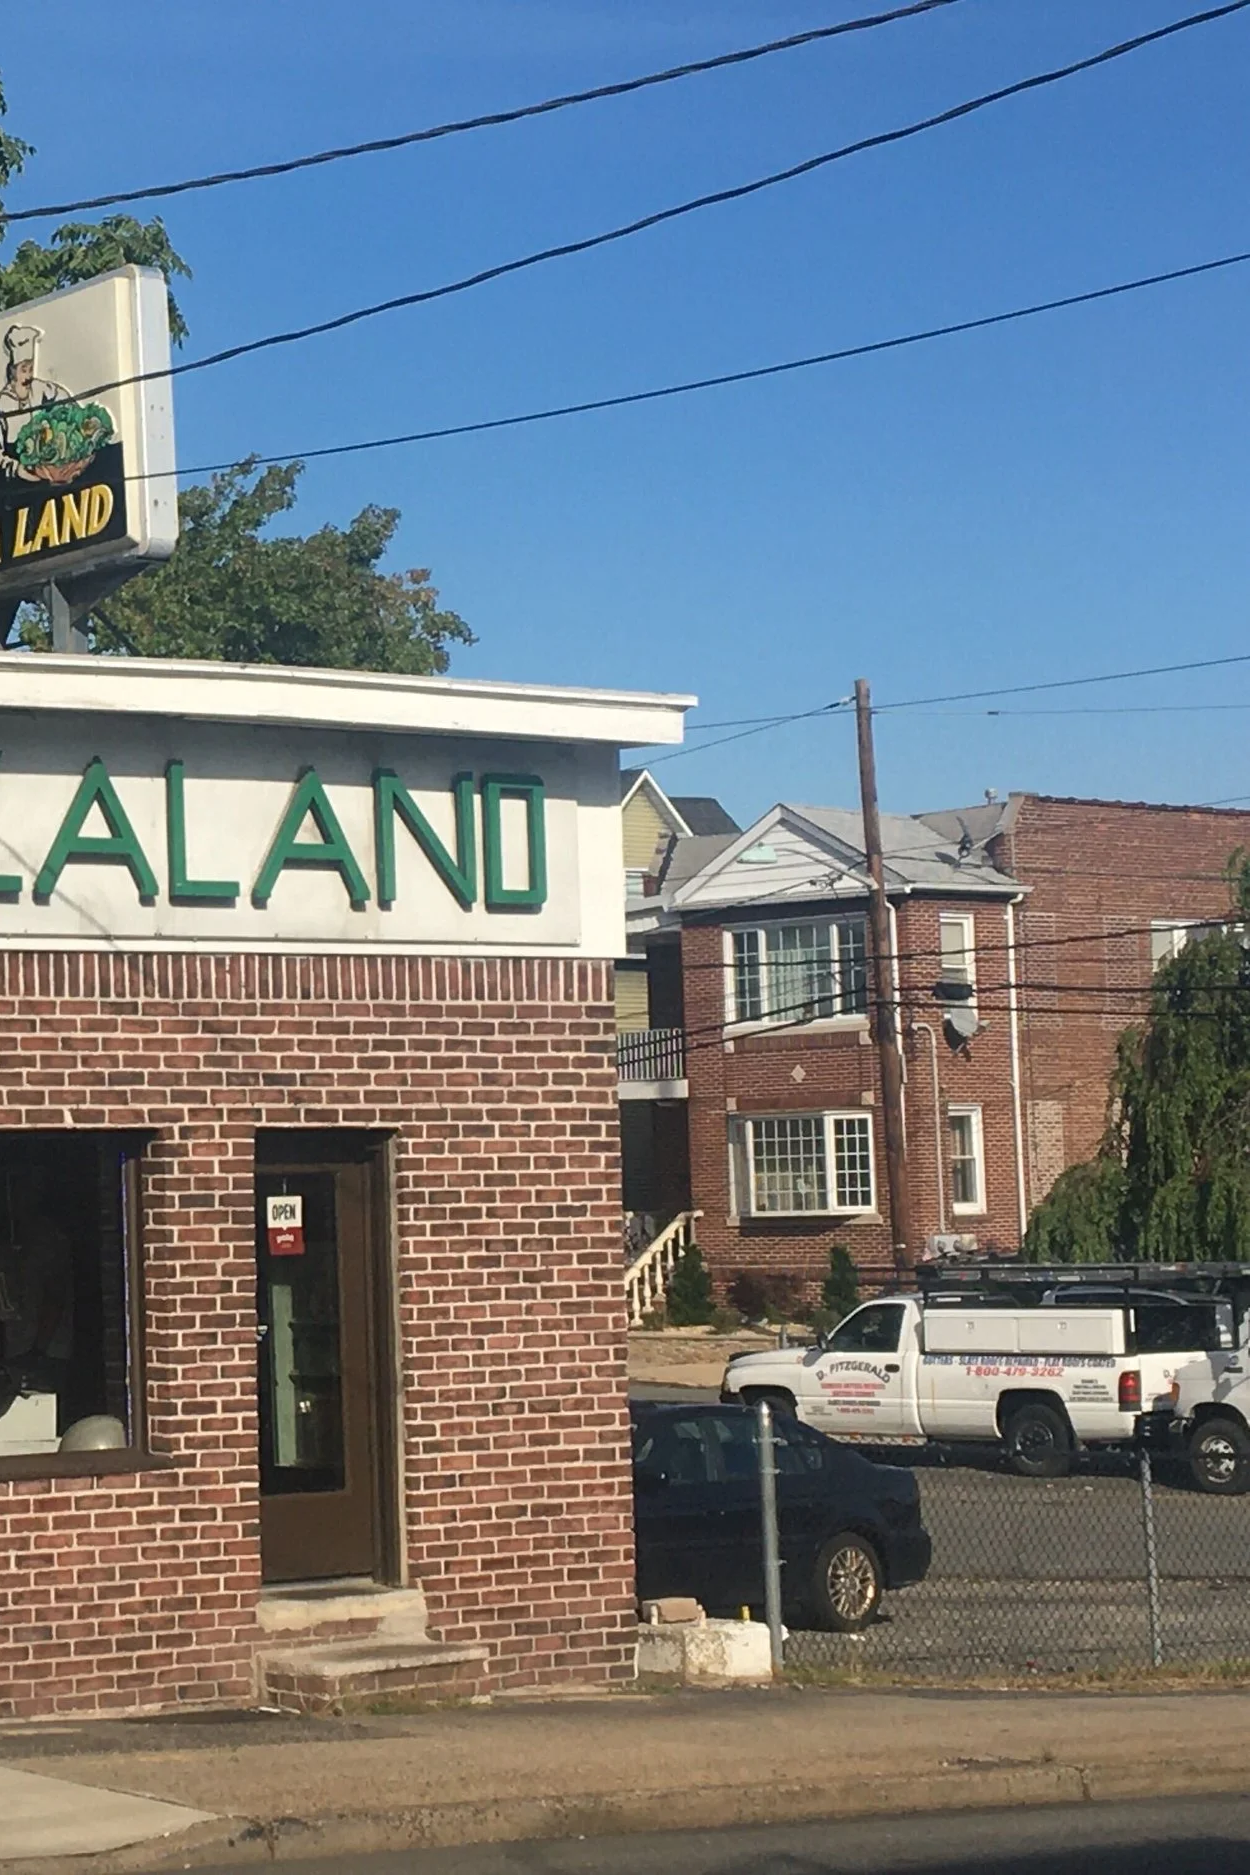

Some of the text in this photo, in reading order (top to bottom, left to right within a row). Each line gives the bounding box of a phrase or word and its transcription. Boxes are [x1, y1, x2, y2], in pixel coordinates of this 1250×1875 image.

[13, 484, 113, 558] LAND
[272, 1204, 296, 1221] OPEN
[830, 1360, 891, 1383] FITZGERALD
